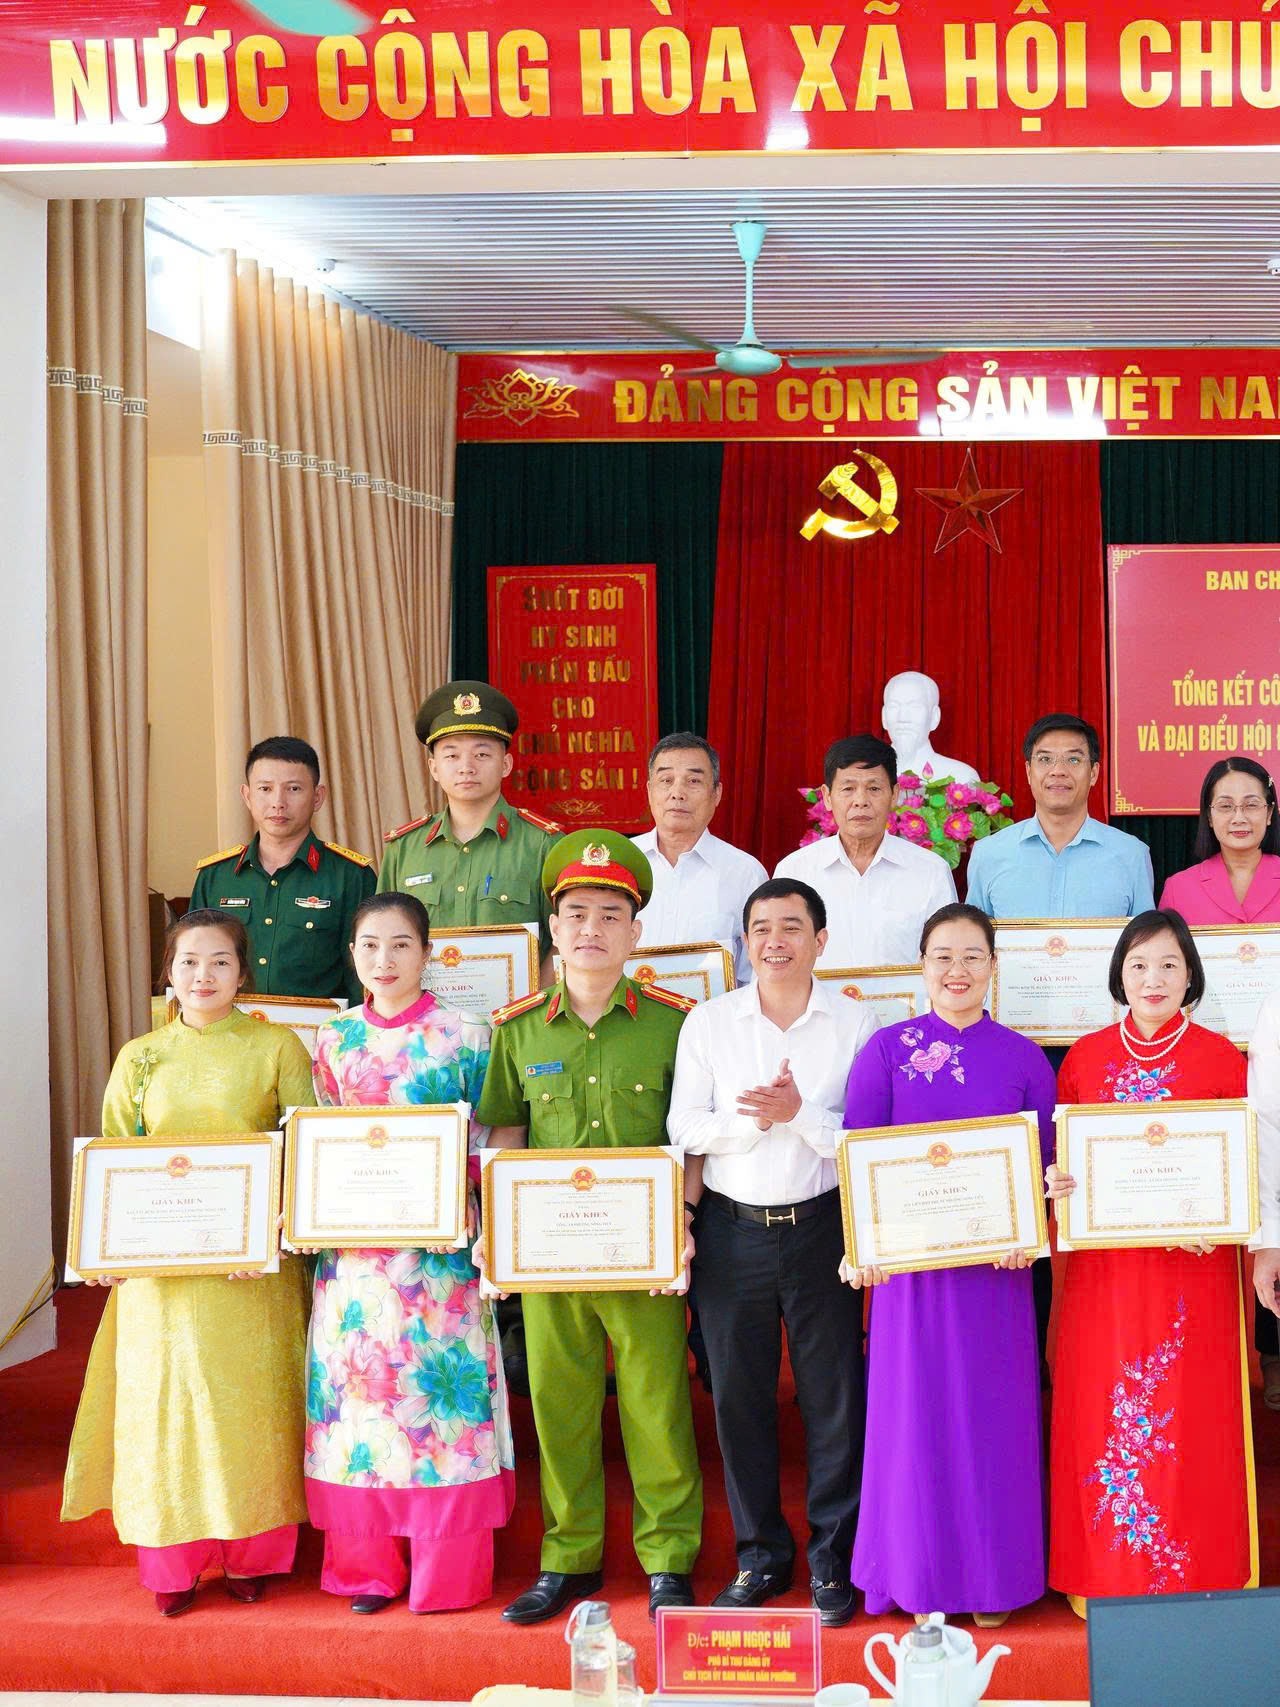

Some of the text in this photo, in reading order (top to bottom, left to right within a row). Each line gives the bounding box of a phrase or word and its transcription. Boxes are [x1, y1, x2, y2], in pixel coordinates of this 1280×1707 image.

[49, 5, 290, 126] NƯỚC
[317, 8, 551, 142] CỘNG
[580, 0, 757, 116] HÒA
[789, 0, 913, 112] XÃ
[944, 0, 1088, 132] HỘI
[612, 364, 758, 423] ĐẢNG
[775, 365, 919, 433] CỘNG
[936, 360, 1049, 423] SẢN
[1063, 365, 1181, 431] VIỆT
[1205, 570, 1249, 591] BAN
[588, 584, 625, 611] ĐỜI
[531, 624, 618, 649] HY SINH
[587, 654, 632, 684] ĐẤU
[1171, 668, 1218, 707] TỔNG
[1222, 669, 1254, 706] KẾT
[552, 696, 596, 719] CHO
[567, 725, 636, 754] NGHĨA
[1137, 720, 1160, 752] VÀ
[1164, 724, 1194, 757] ĐẠI
[1198, 714, 1239, 751] BIỂU
[1243, 719, 1273, 757] HỘI
[579, 761, 626, 791] SẢN
[711, 1630, 741, 1652] PHẠM
[743, 1630, 771, 1652] NGỌC
